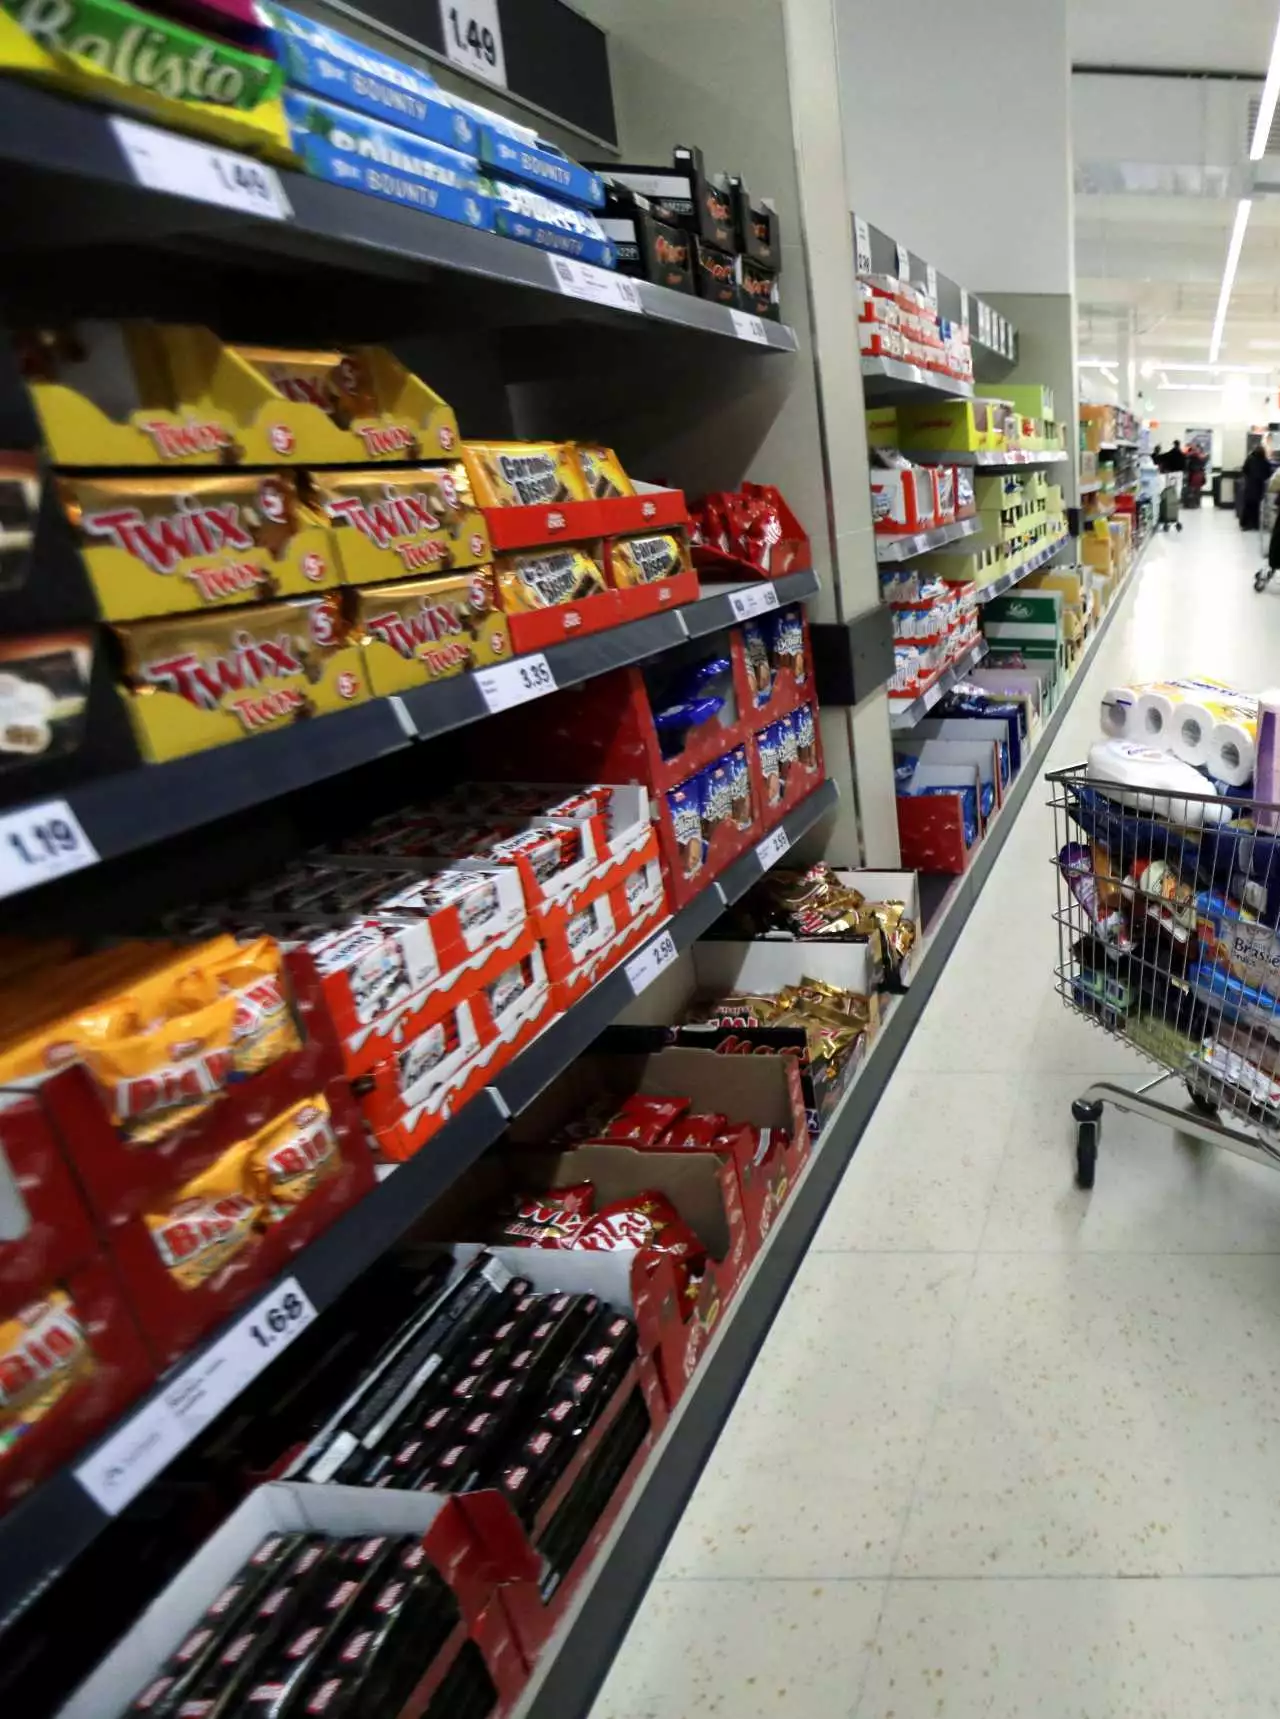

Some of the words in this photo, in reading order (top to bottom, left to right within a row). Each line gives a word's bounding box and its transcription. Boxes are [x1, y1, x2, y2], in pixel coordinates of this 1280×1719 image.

[449, 7, 496, 67] 1.49
[519, 662, 550, 689] 3.35
[6, 818, 79, 866] 1.19
[651, 934, 674, 966] 2.59
[249, 1293, 303, 1348] 1.68
